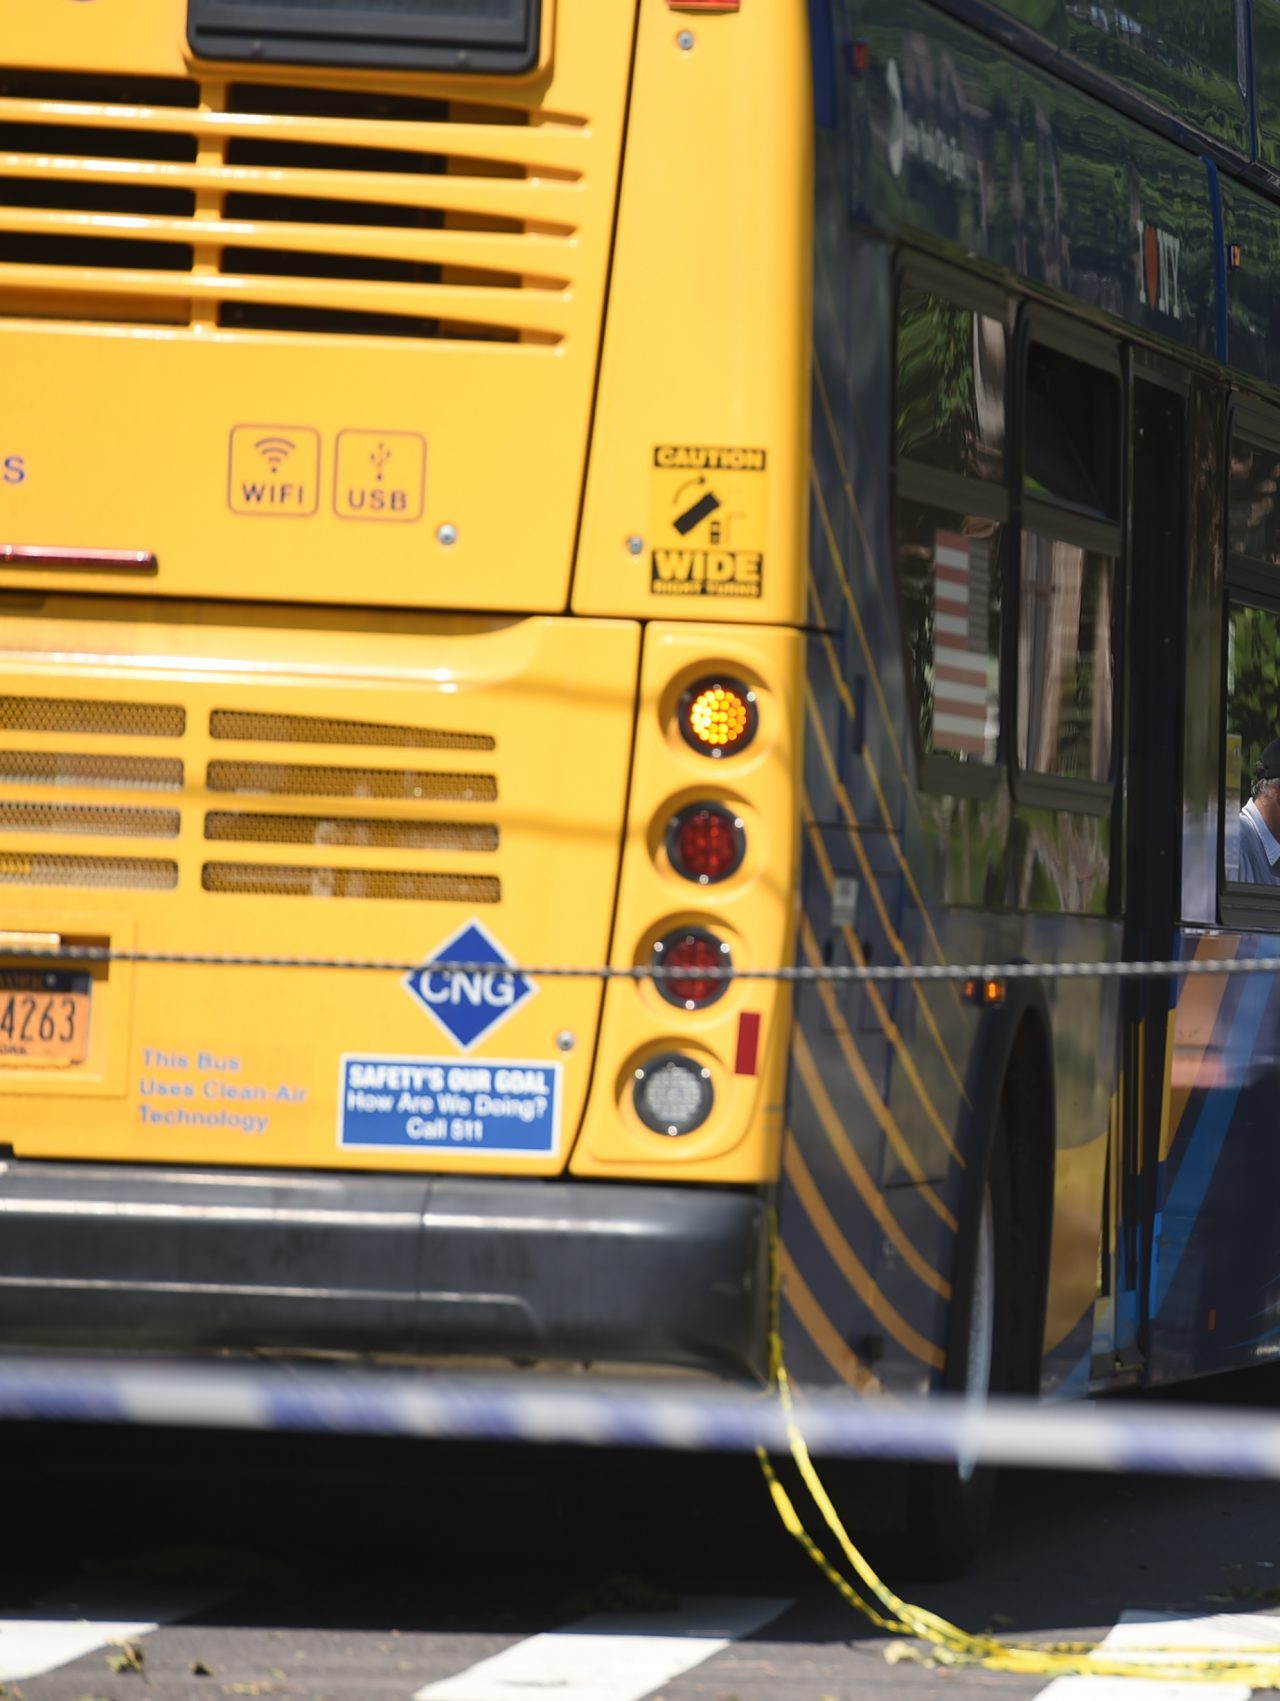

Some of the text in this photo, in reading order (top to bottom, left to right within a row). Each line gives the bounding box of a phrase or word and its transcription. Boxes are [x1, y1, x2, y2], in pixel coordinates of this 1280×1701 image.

[4, 455, 25, 484] S
[656, 448, 763, 469] CAUTION
[242, 483, 304, 504] WIFI
[348, 489, 408, 511] USB
[655, 550, 760, 582] WIDE
[420, 968, 515, 1007] CNG
[0, 993, 75, 1042] 4263
[144, 1048, 240, 1071] This Bus
[140, 1077, 195, 1096] Uses
[349, 1063, 550, 1096] SAFETY'S OUR GOAL
[139, 1104, 268, 1133] Technology
[346, 1089, 548, 1123] How Are We Doing?
[406, 1115, 483, 1142] Call 511
